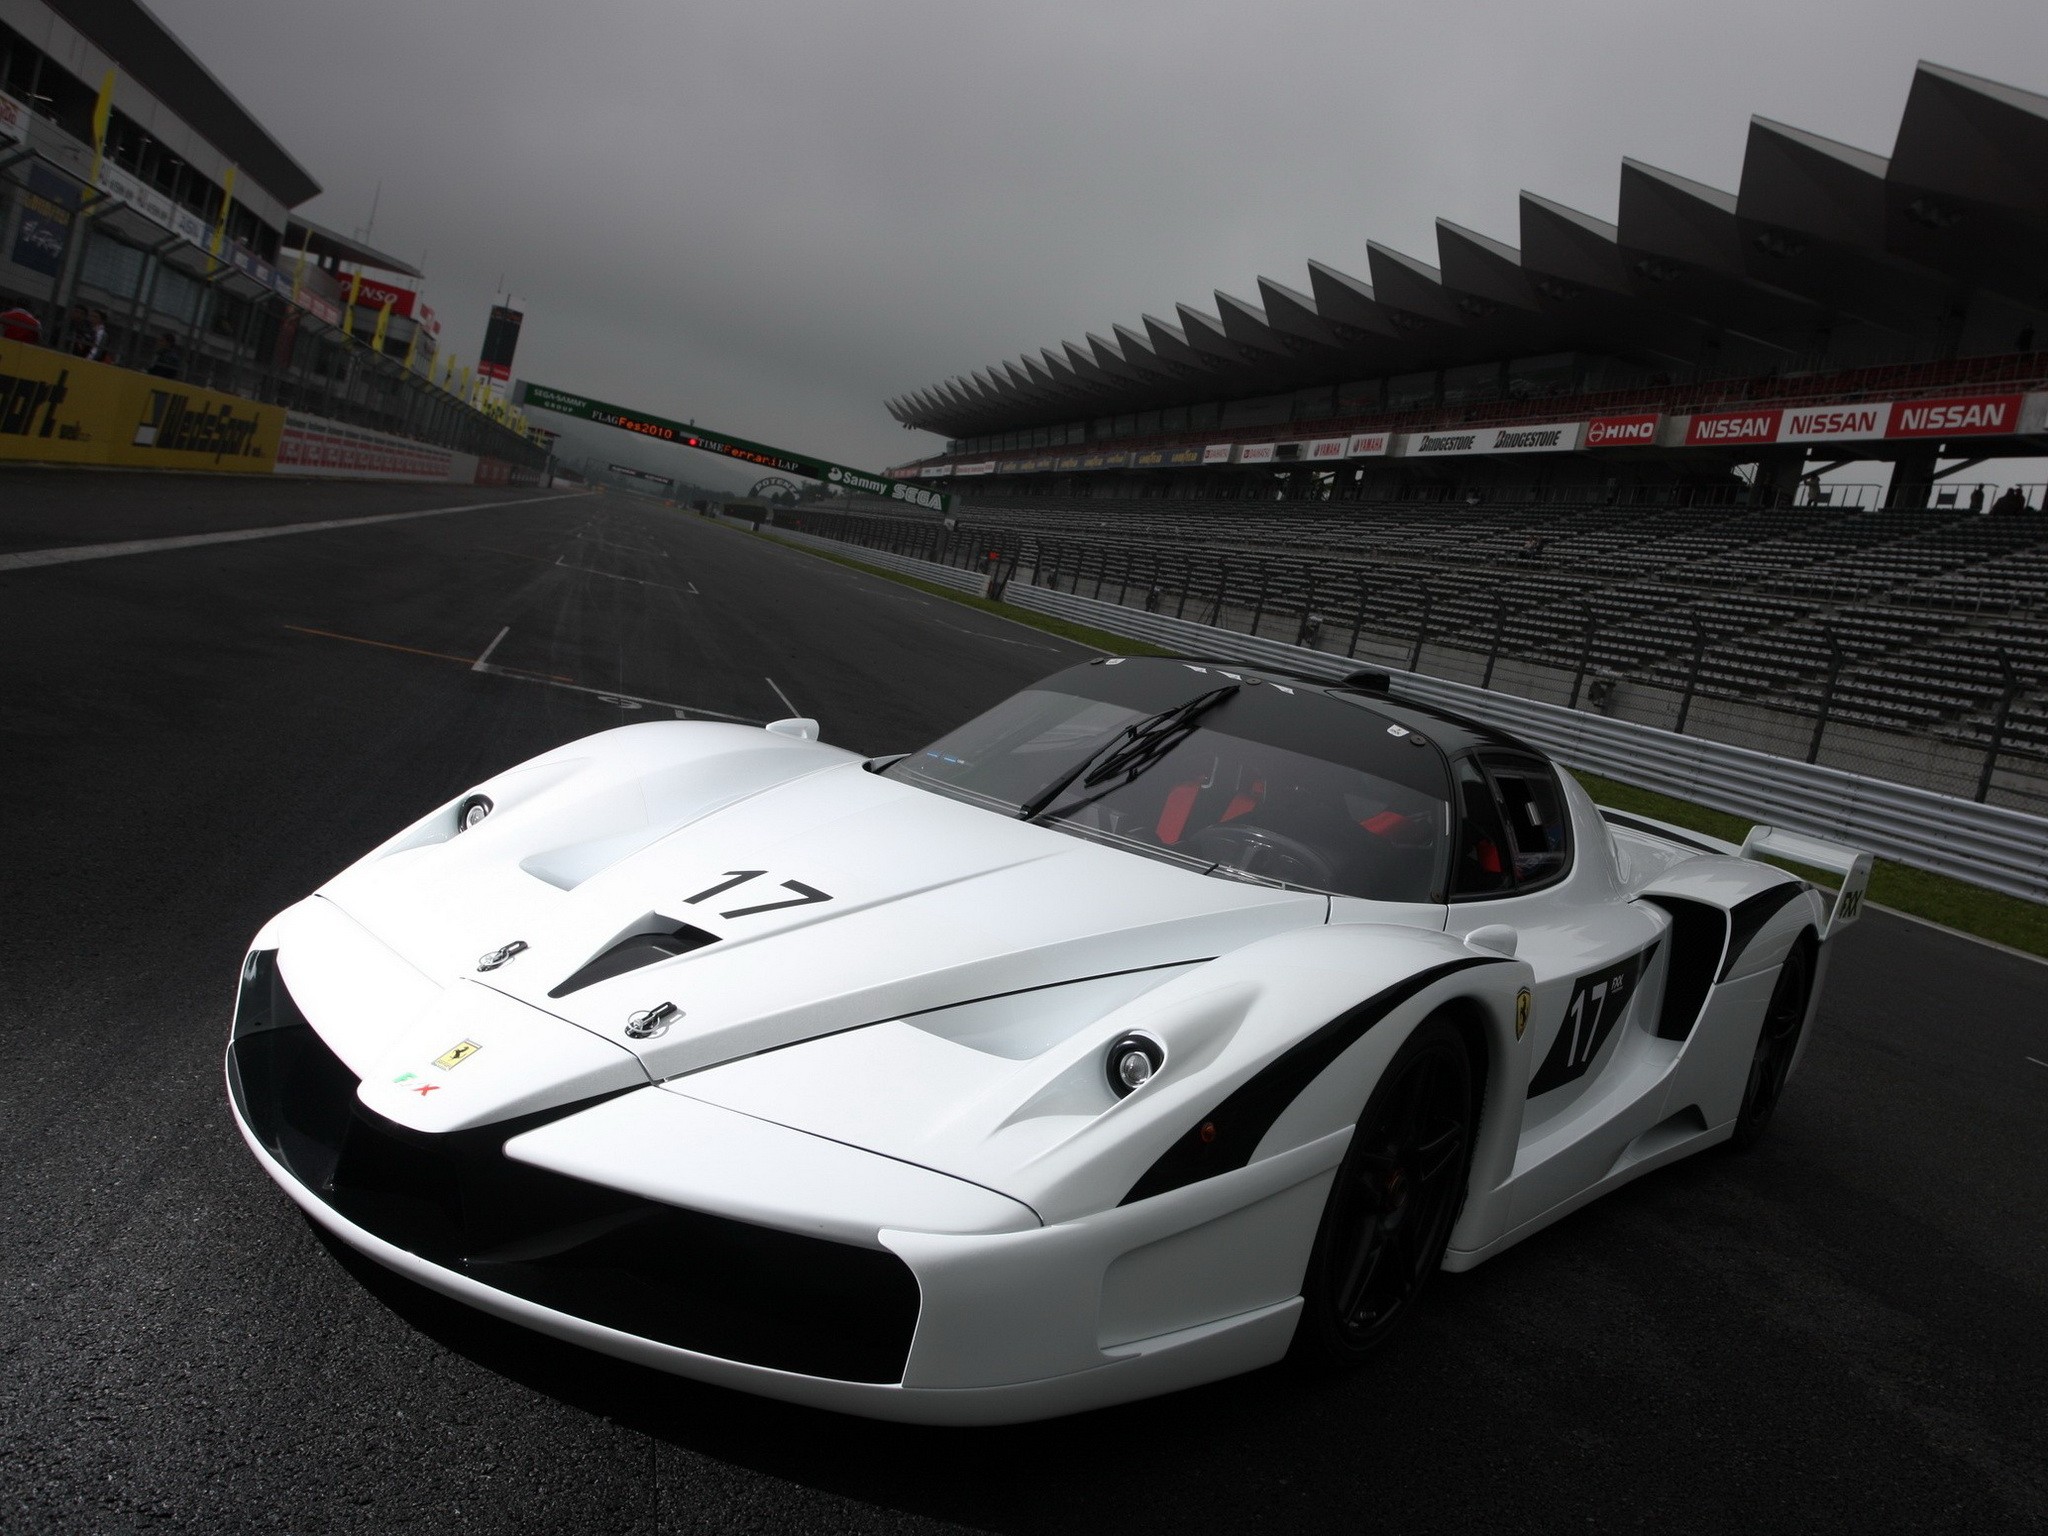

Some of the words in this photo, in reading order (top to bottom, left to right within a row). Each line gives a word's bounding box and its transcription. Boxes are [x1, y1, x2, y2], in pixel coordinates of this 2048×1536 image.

[340, 280, 398, 304] DNSO
[592, 410, 618, 425] FLAG
[618, 416, 674, 439] Fes2010
[1695, 417, 1771, 439] NISSAN
[1789, 411, 1877, 435] NISSAN
[1899, 403, 2006, 429] NISSAN
[1418, 435, 1476, 452] BRIDGESTONE
[1494, 430, 1562, 449] BRIDGESTONE
[1605, 422, 1655, 440] HINO
[699, 438, 724, 451] TIME
[777, 459, 799, 471] LAP
[843, 472, 888, 495] Sammy
[892, 484, 942, 511] SEGA
[683, 870, 834, 919] 17
[1566, 981, 1608, 1067] 17
